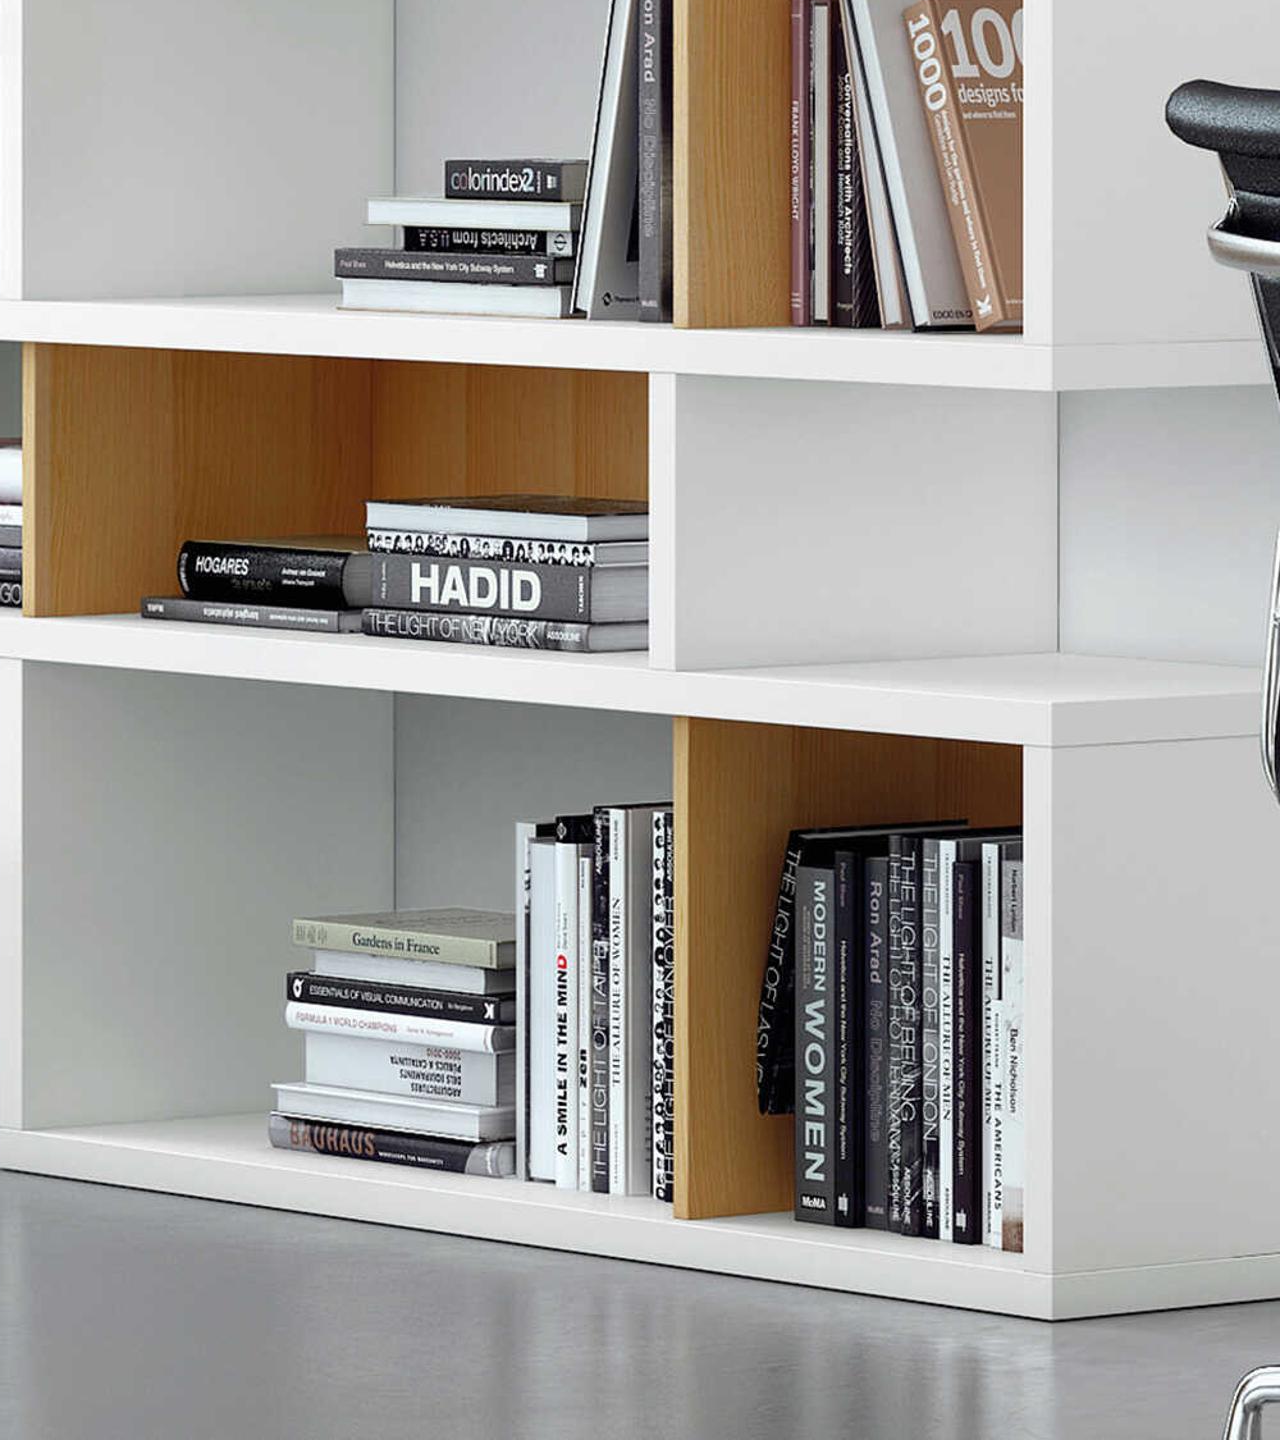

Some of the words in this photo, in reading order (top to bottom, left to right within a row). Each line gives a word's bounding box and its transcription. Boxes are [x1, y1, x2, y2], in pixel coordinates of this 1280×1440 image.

[643, 32, 656, 82] Arad
[908, 14, 948, 111] 1000
[940, 7, 1023, 80] 10
[958, 85, 1007, 108] designs
[791, 100, 799, 136] FRANK
[844, 73, 852, 170] Conversations
[791, 138, 799, 173] LLOYD
[451, 167, 534, 192] colorindex2
[791, 175, 799, 220] WRIGHT
[844, 173, 852, 204] with
[453, 231, 478, 247] from
[481, 232, 539, 250] Architects
[844, 206, 852, 274] Architects
[195, 556, 249, 576] HOGARES
[410, 562, 541, 611] HADID
[368, 612, 398, 635] THE
[398, 614, 439, 637] LIGHT
[439, 617, 460, 638] OF
[461, 619, 495, 642] NEW
[496, 622, 539, 645] YORK
[782, 850, 801, 890] THE
[890, 853, 901, 894] THE
[901, 851, 916, 901] THE
[923, 853, 938, 905] THE
[870, 881, 882, 924] Ron
[351, 932, 393, 950] Gardens
[394, 937, 404, 951] in
[406, 938, 440, 956] France
[612, 898, 620, 965] WOMEN
[767, 894, 793, 967] LIGHT
[814, 880, 826, 991] MODERN
[890, 898, 901, 960] LIGHT
[901, 907, 916, 981] LIGHT
[923, 909, 938, 983] LIGHT
[612, 966, 620, 985] OF
[870, 932, 882, 983] Arad
[943, 955, 951, 984] THE
[957, 953, 965, 995] Helvetica
[309, 984, 351, 999] ESSENTIALS
[351, 988, 360, 1000] OF
[360, 989, 384, 1003] VISUAL
[384, 993, 443, 1010] COMMUNICATION
[557, 955, 568, 1007] MIND
[764, 966, 780, 996] OF
[890, 967, 901, 1000] OF
[612, 988, 620, 1050] ALLURE
[901, 985, 916, 1021] OF
[923, 987, 938, 1024] OF
[943, 991, 951, 1055] ALLURE
[957, 997, 965, 1014] and
[557, 1013, 568, 1047] THE
[593, 1014, 607, 1050] OF
[758, 1001, 775, 1049] LAS
[1010, 1028, 1019, 1051] Ben
[447, 1074, 462, 1086] DELS
[557, 1054, 568, 1073] IN
[579, 1049, 587, 1089] zen
[612, 1054, 620, 1088] THE
[901, 1026, 916, 1121] BEIJING
[943, 1058, 951, 1079] OF
[957, 1057, 965, 1077] York
[1010, 1054, 1019, 1113] Nicholson
[411, 1083, 462, 1098] ARQUITECTURES
[593, 1056, 607, 1126] LIGHT
[805, 999, 825, 1181] WOMEN
[923, 1028, 938, 1140] LONDON
[943, 1086, 951, 1121] MEN
[957, 1079, 965, 1097] City
[994, 1083, 1002, 1110] THE
[557, 1080, 568, 1137] SMILE
[288, 1121, 376, 1157] BAUHAUS
[557, 1144, 568, 1156] A
[593, 1129, 607, 1178] THE
[994, 1117, 1002, 1210] AMERICANS
